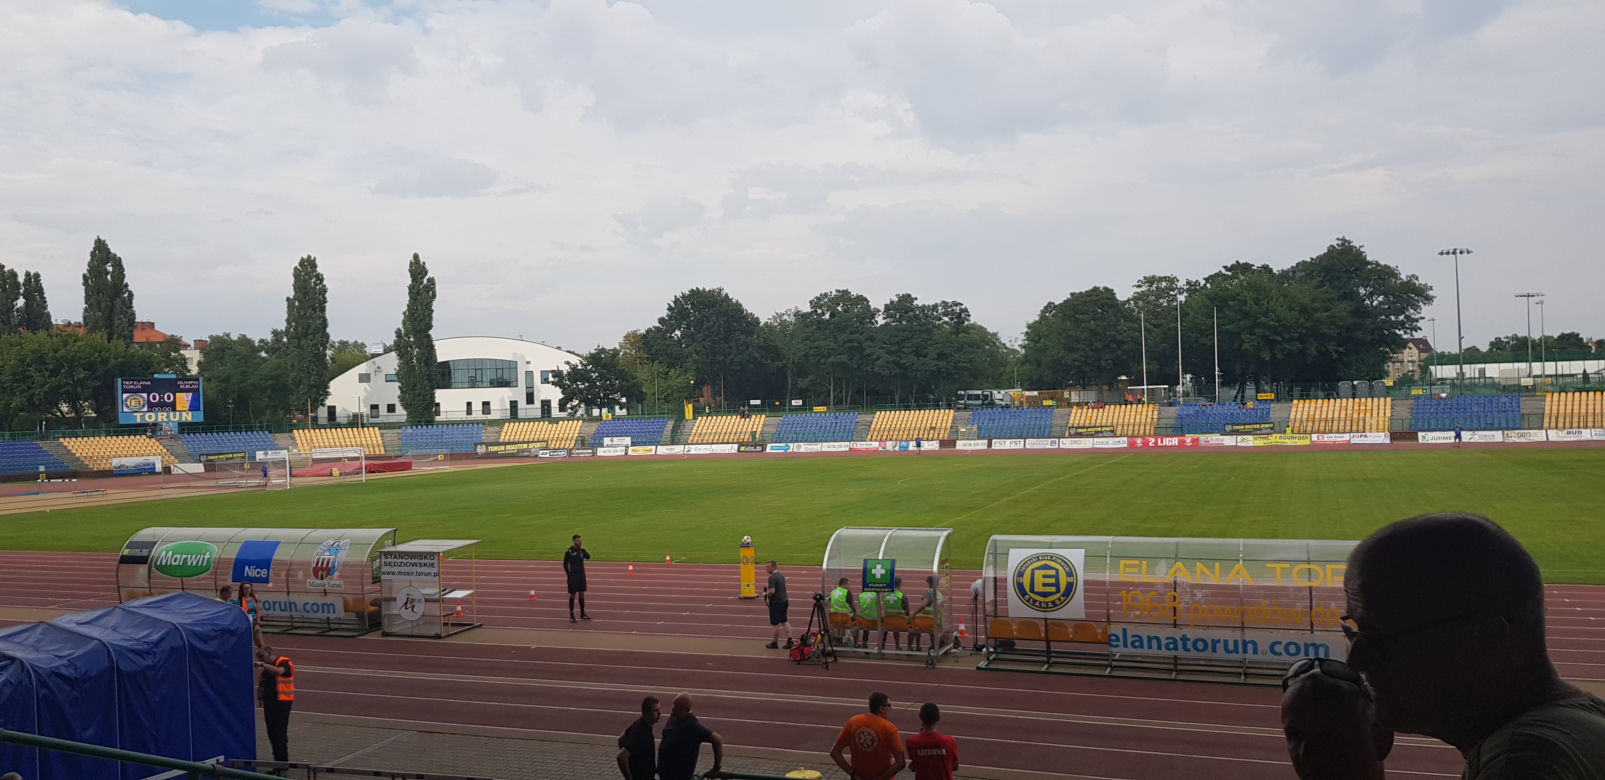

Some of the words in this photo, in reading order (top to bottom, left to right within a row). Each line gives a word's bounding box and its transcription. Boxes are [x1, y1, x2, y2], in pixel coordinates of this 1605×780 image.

[149, 392, 174, 402] 0:0
[1148, 437, 1155, 446] 2
[1157, 437, 1179, 446] LIGA
[156, 550, 210, 566] Marwit
[244, 565, 268, 578] Nice
[381, 570, 440, 578] www.mosir.torun.pl
[1119, 560, 1254, 586] ELANA
[1033, 569, 1057, 592] E
[1119, 590, 1182, 620] 1968
[1190, 599, 1304, 627] powodów
[1311, 601, 1341, 627] do
[1107, 627, 1331, 659] elanatorun.com
